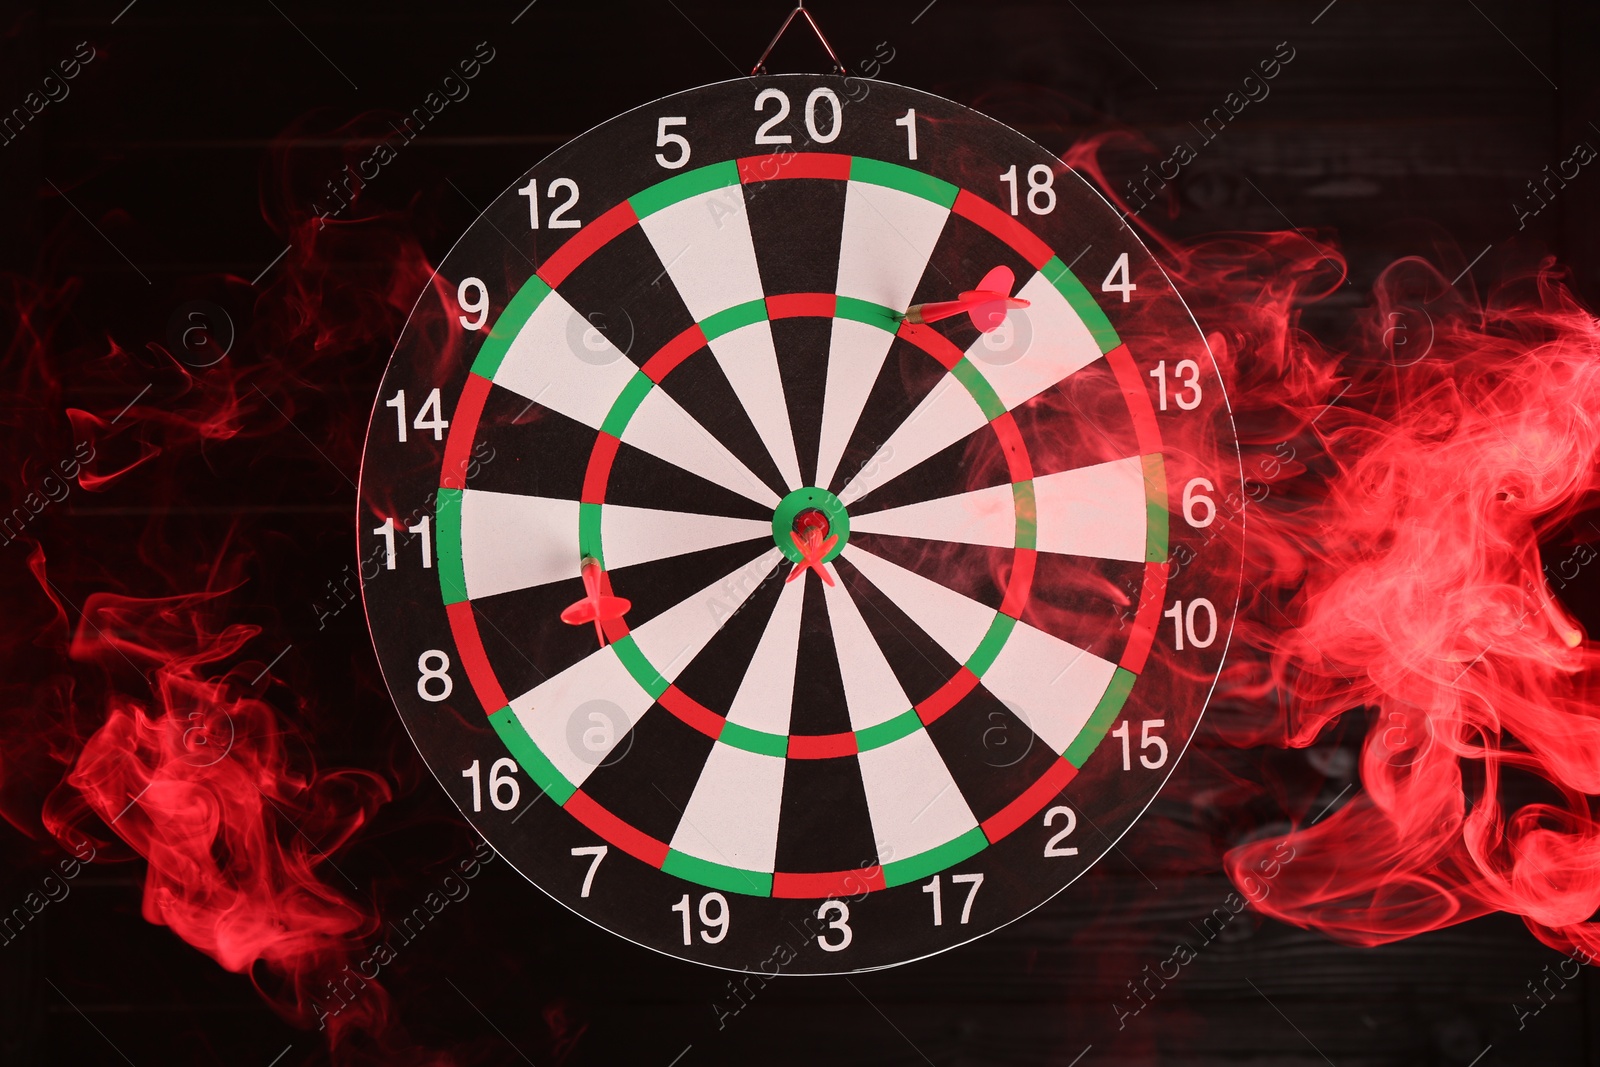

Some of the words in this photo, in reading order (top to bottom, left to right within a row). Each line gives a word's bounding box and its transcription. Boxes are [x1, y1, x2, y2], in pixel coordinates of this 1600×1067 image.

[754, 87, 842, 145] 20
[895, 108, 918, 161] 1
[655, 116, 691, 170] 5
[518, 177, 582, 230] 12
[999, 164, 1057, 216] 18
[457, 276, 490, 331] 9
[1101, 252, 1137, 303] 4
[1149, 359, 1202, 411] 13
[386, 388, 449, 443] 14
[1182, 477, 1217, 528] 6
[373, 515, 432, 570] 11
[1164, 597, 1218, 651] 10
[417, 649, 453, 702] 8
[1112, 719, 1169, 771] 15
[462, 757, 520, 812] 16
[1043, 805, 1079, 858] 2
[570, 845, 608, 898] 7
[671, 891, 730, 946] 19
[817, 900, 853, 952] 3
[922, 873, 984, 926] 17
